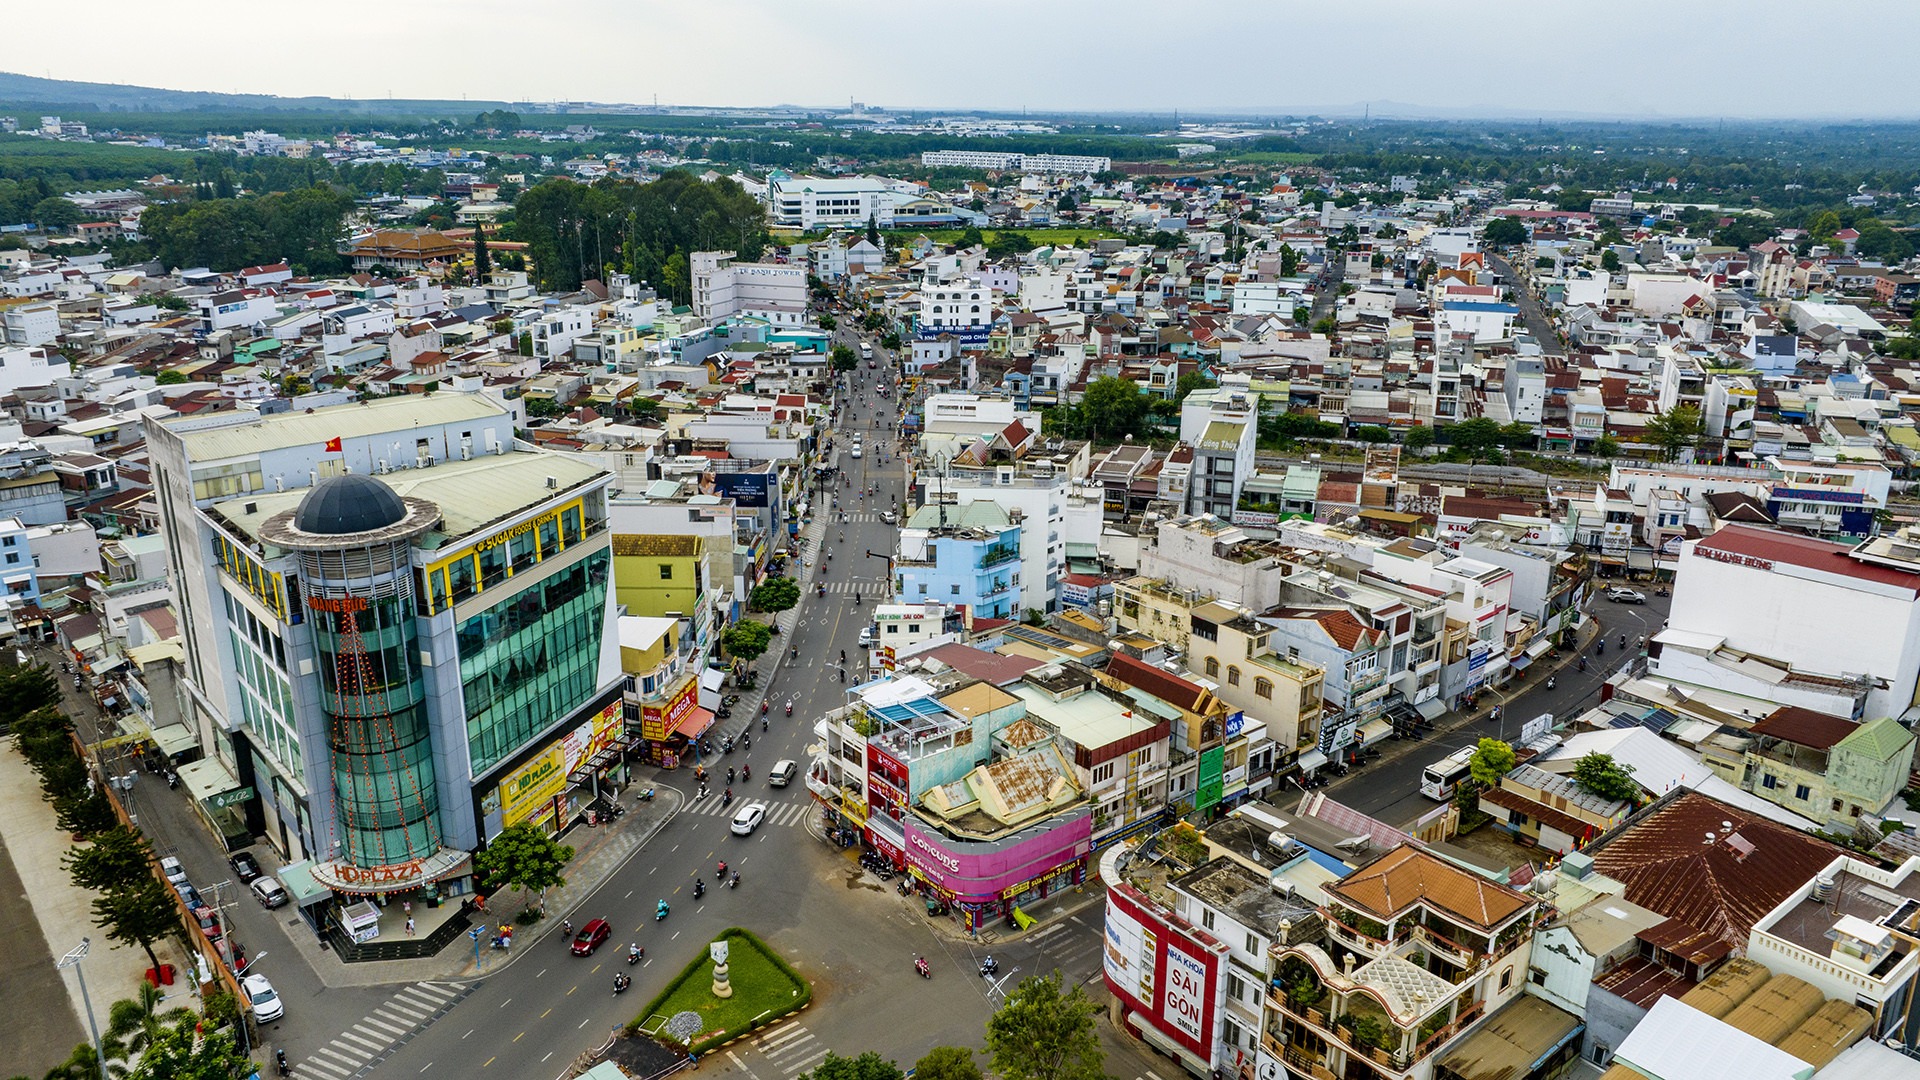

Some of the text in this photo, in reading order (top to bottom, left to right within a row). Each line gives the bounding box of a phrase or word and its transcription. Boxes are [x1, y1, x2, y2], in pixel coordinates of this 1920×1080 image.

[1774, 490, 1789, 498] GA
[1793, 492, 1821, 500] LONG
[515, 522, 532, 536] FOODS
[1448, 524, 1468, 532] KIM
[1694, 547, 1712, 558] KIM
[1744, 557, 1772, 570] HÙNG
[670, 696, 690, 723] MEGA
[1227, 721, 1239, 733] NỘI
[882, 757, 898, 772] MIXUE
[518, 762, 552, 791] HD PLAZA
[878, 837, 898, 856] MIXUE
[334, 865, 359, 882] HD
[361, 863, 423, 882] PLAZA
[1043, 872, 1056, 881] MUA
[1056, 867, 1061, 875] 3
[1167, 948, 1205, 977] NHA KHOA
[1172, 969, 1198, 997] SÀI
[1167, 990, 1199, 1024] GÒN
[1177, 1017, 1199, 1037] SMILE
